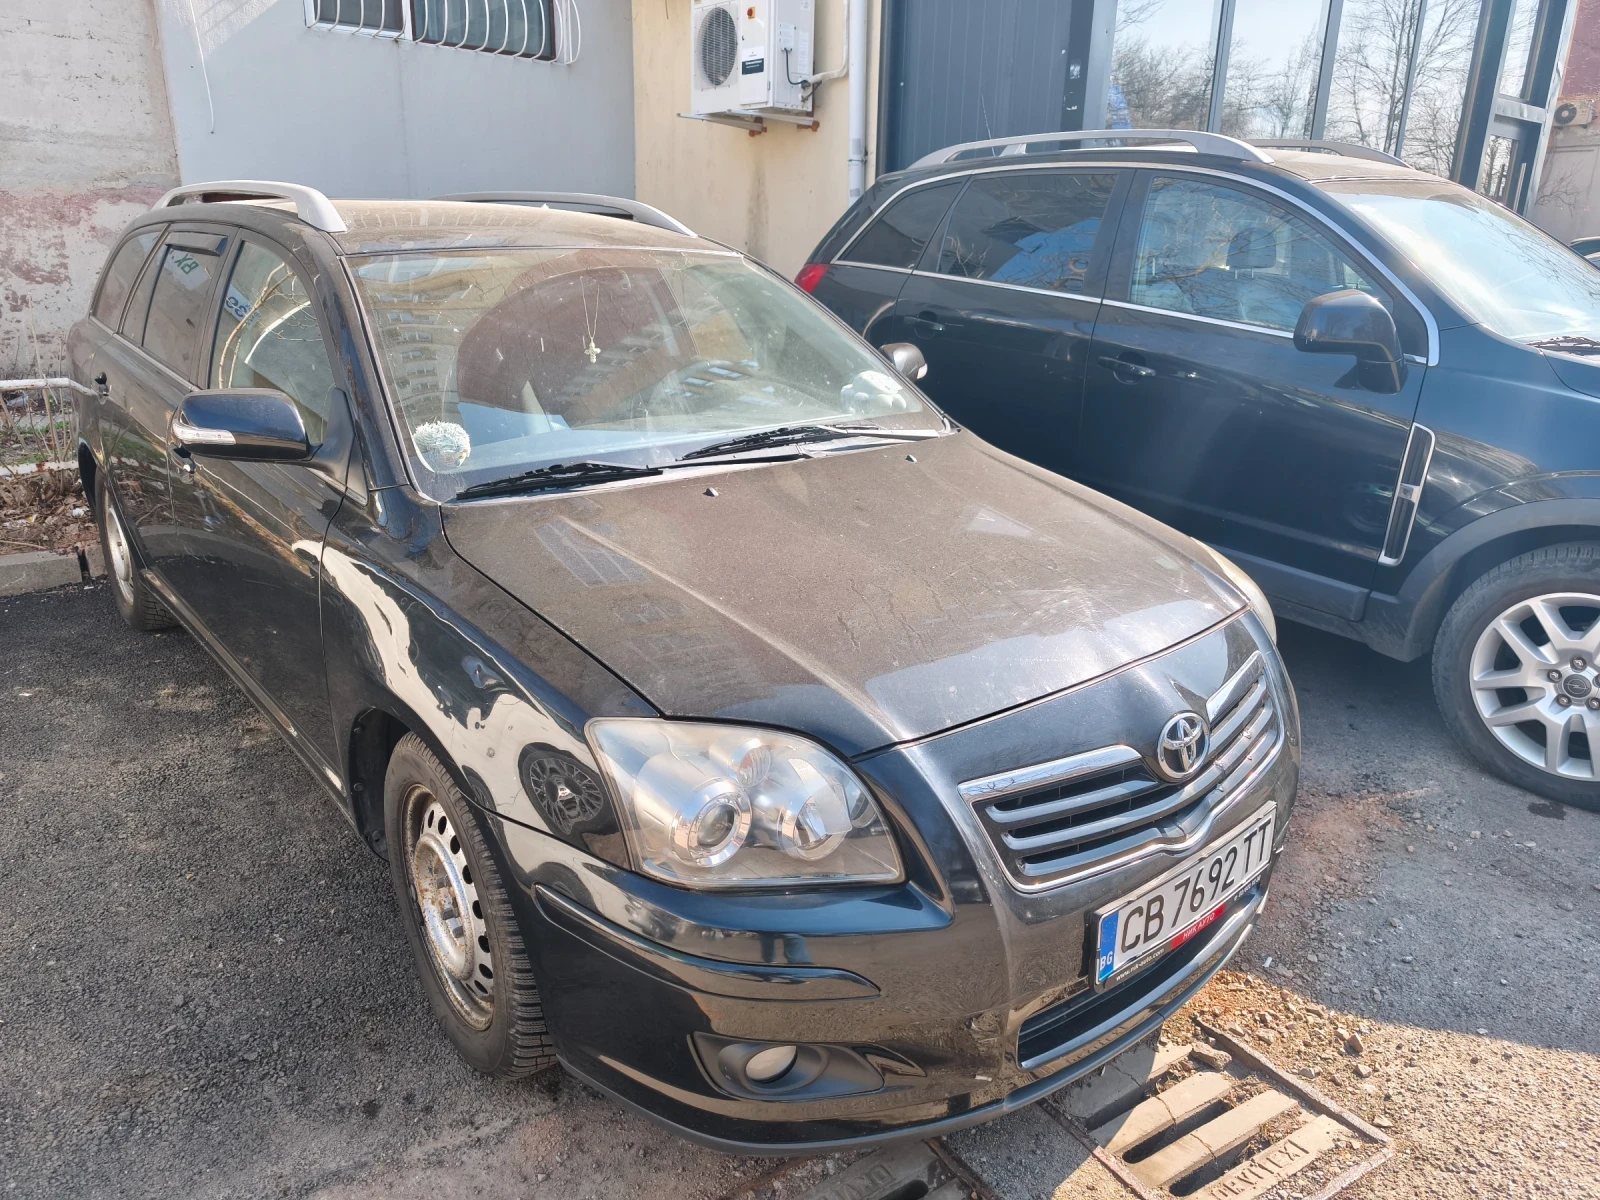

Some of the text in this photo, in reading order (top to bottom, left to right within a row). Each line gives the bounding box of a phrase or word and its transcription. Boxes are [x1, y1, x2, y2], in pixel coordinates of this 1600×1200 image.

[1121, 894, 1165, 954] CB
[1171, 846, 1238, 929] 7692
[1243, 818, 1272, 875] TT
[1100, 951, 1113, 971] BG
